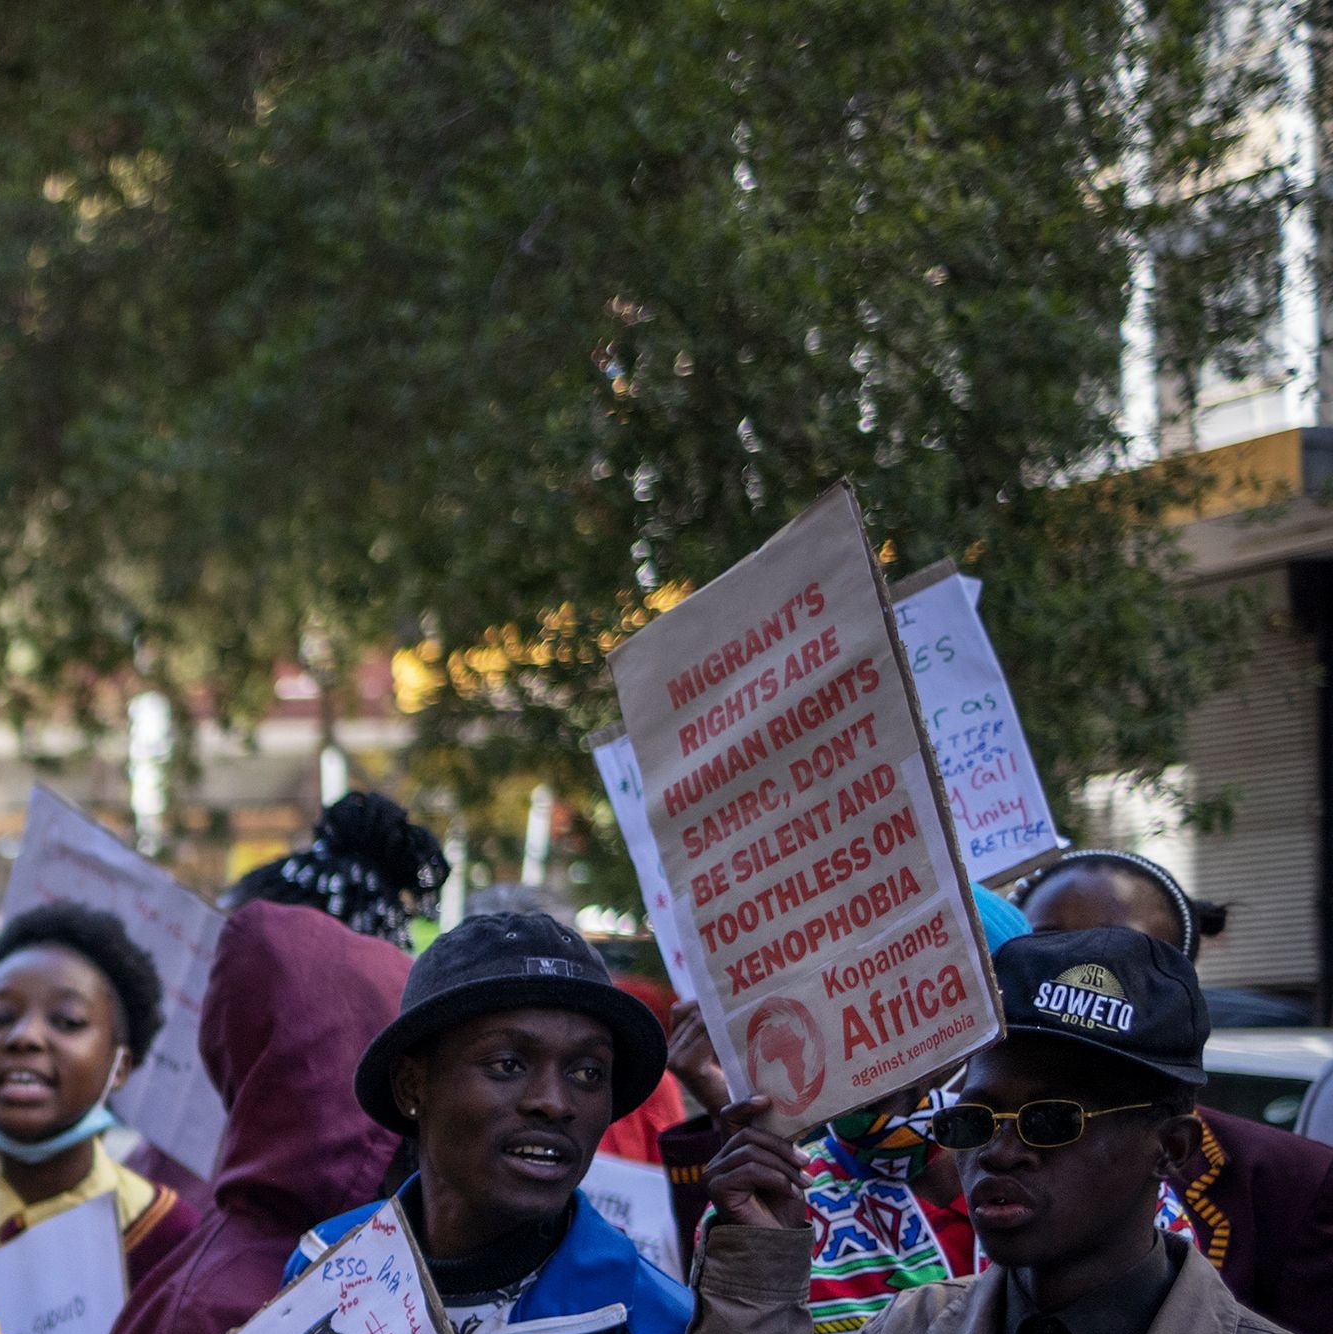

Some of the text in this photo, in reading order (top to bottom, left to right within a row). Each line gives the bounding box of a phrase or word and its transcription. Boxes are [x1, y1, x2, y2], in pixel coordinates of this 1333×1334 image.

[667, 581, 827, 711] MIGRANT'S
[678, 625, 841, 758] RIGHTS ARE
[663, 657, 881, 818] HUMAN RIGHTS
[682, 772, 792, 860] SAHRC,
[793, 712, 878, 798] DON'T
[934, 720, 1004, 750] ETTER
[690, 861, 731, 908] BE
[732, 797, 835, 888] SILENT
[837, 762, 898, 827] AND
[697, 805, 918, 955] TOOTHLESS ON
[725, 866, 922, 997] XENOPHOBIA
[820, 911, 951, 1001] Kopanang
[840, 962, 969, 1062] Africa
[850, 1013, 976, 1088] against xenophobia
[1033, 982, 1134, 1032] SOWETO
[1061, 1014, 1095, 1030] GOLD
